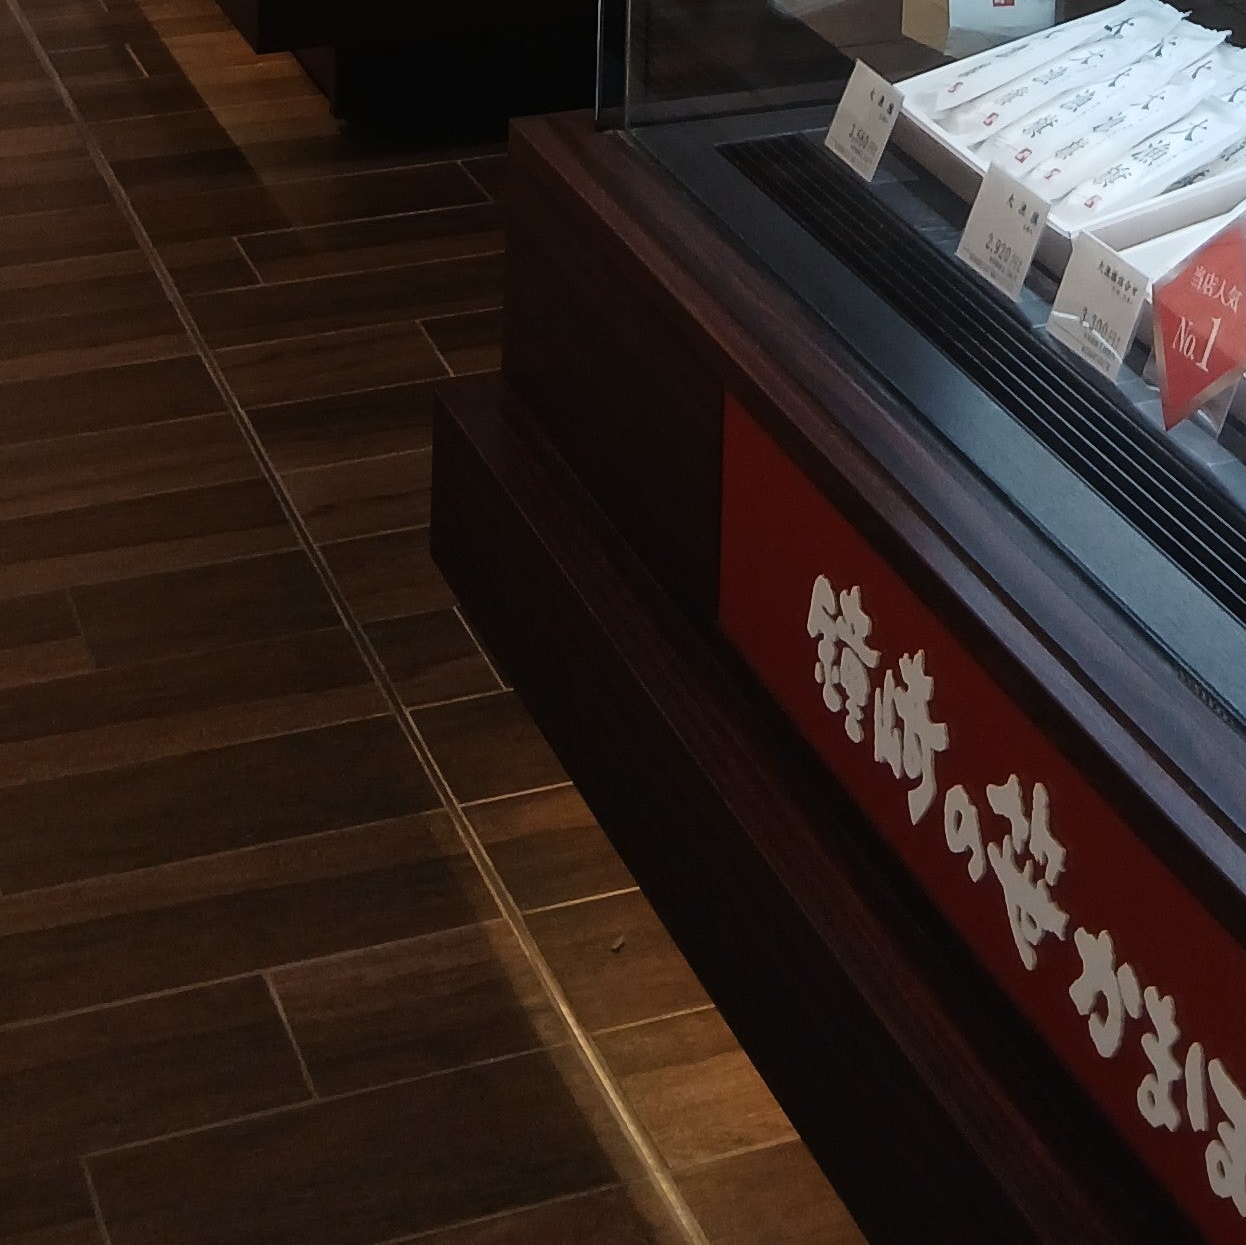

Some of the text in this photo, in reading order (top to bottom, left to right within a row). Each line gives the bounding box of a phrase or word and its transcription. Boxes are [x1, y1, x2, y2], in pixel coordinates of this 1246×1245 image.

[1189, 264, 1244, 314] 当店人気
[1171, 315, 1222, 374] No.1
